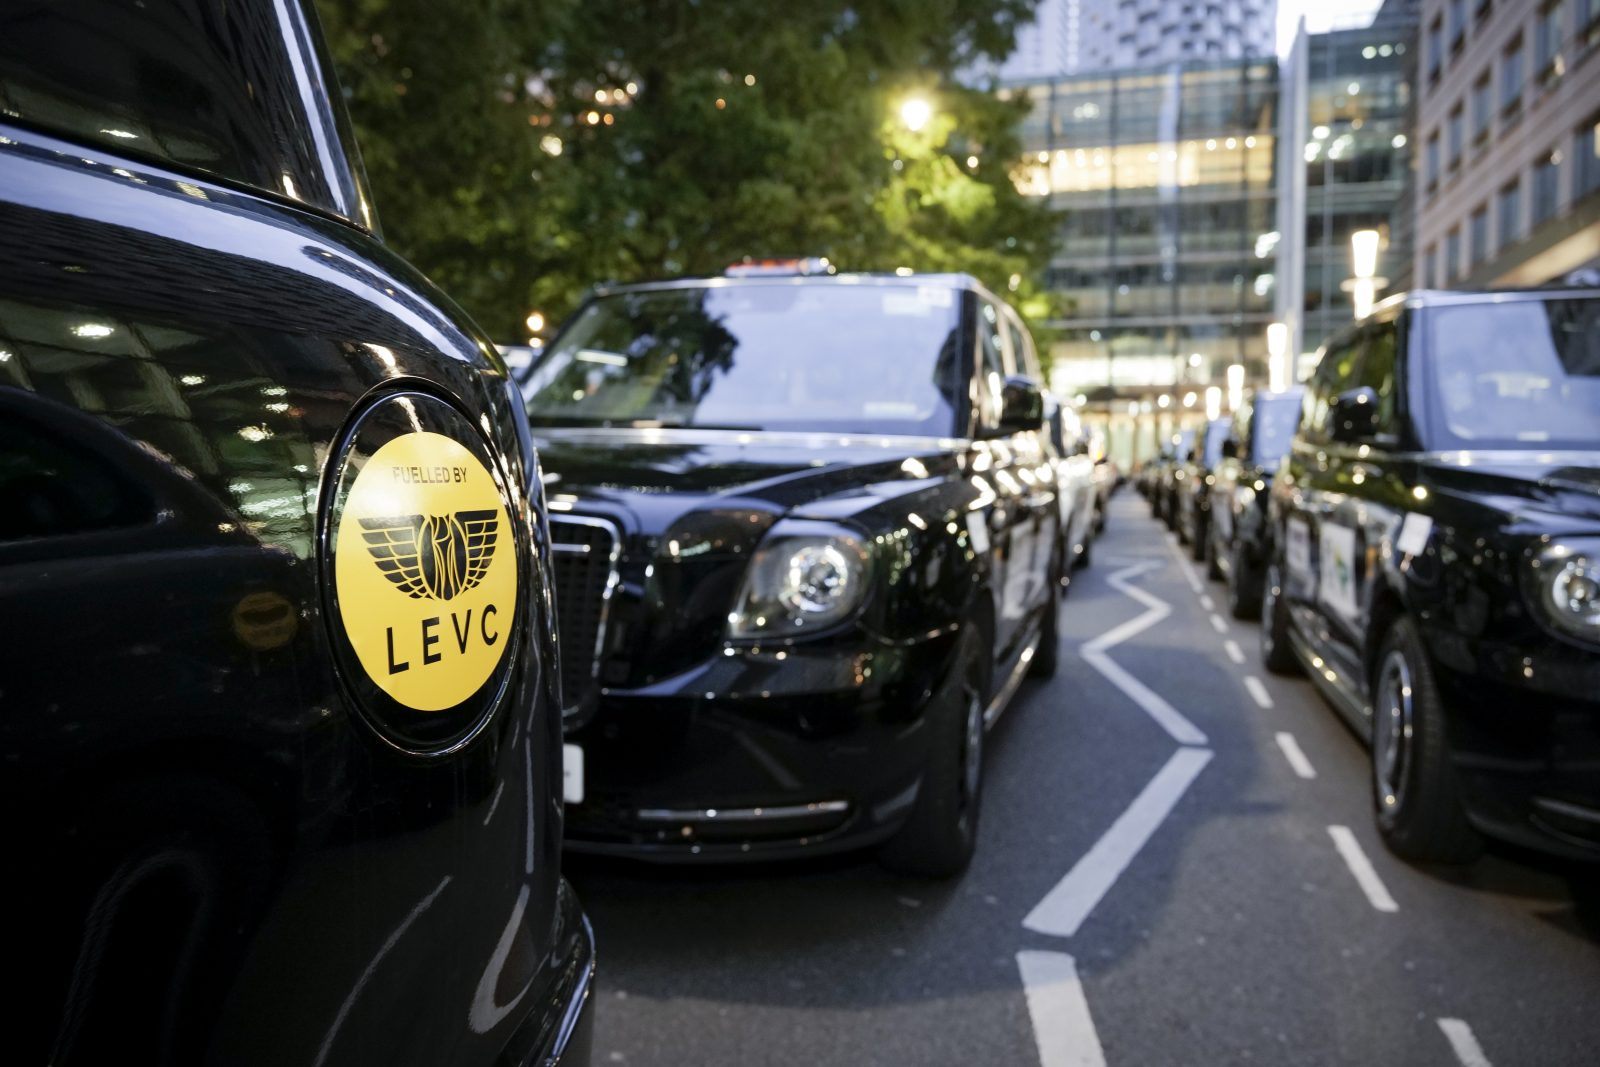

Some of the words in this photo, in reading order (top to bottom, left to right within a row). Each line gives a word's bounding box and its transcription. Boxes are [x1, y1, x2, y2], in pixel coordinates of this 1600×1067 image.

[392, 466, 451, 483] FUELLED
[453, 467, 467, 483] BY
[386, 604, 499, 675] LEVC
